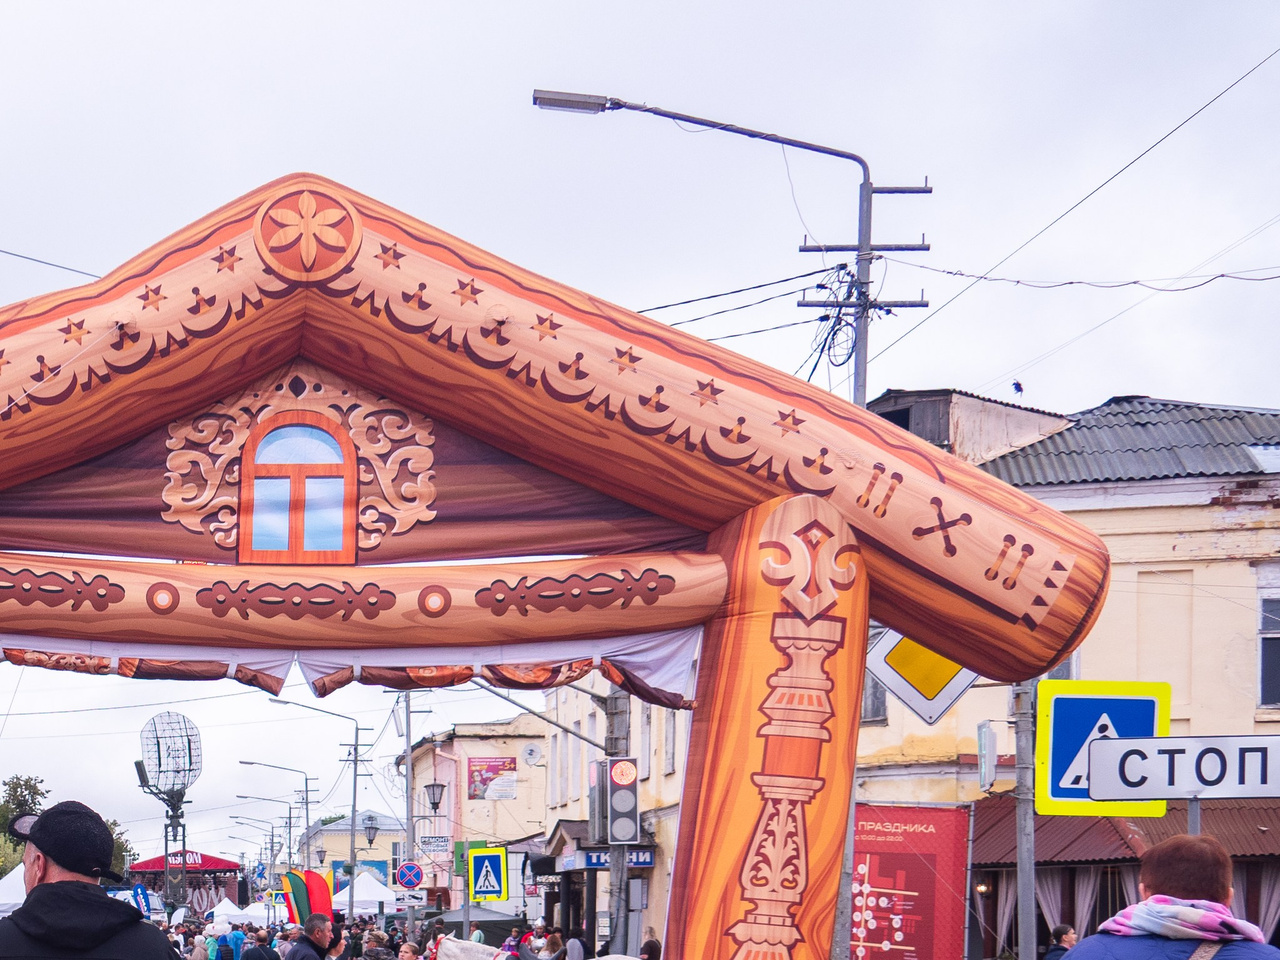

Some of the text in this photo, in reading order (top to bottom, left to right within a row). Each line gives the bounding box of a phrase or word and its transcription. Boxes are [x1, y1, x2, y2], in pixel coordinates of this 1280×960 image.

[1118, 747, 1268, 788] СТОП
[858, 821, 936, 834] ПРАЗДНИКА
[588, 851, 651, 863] ТКНИ
